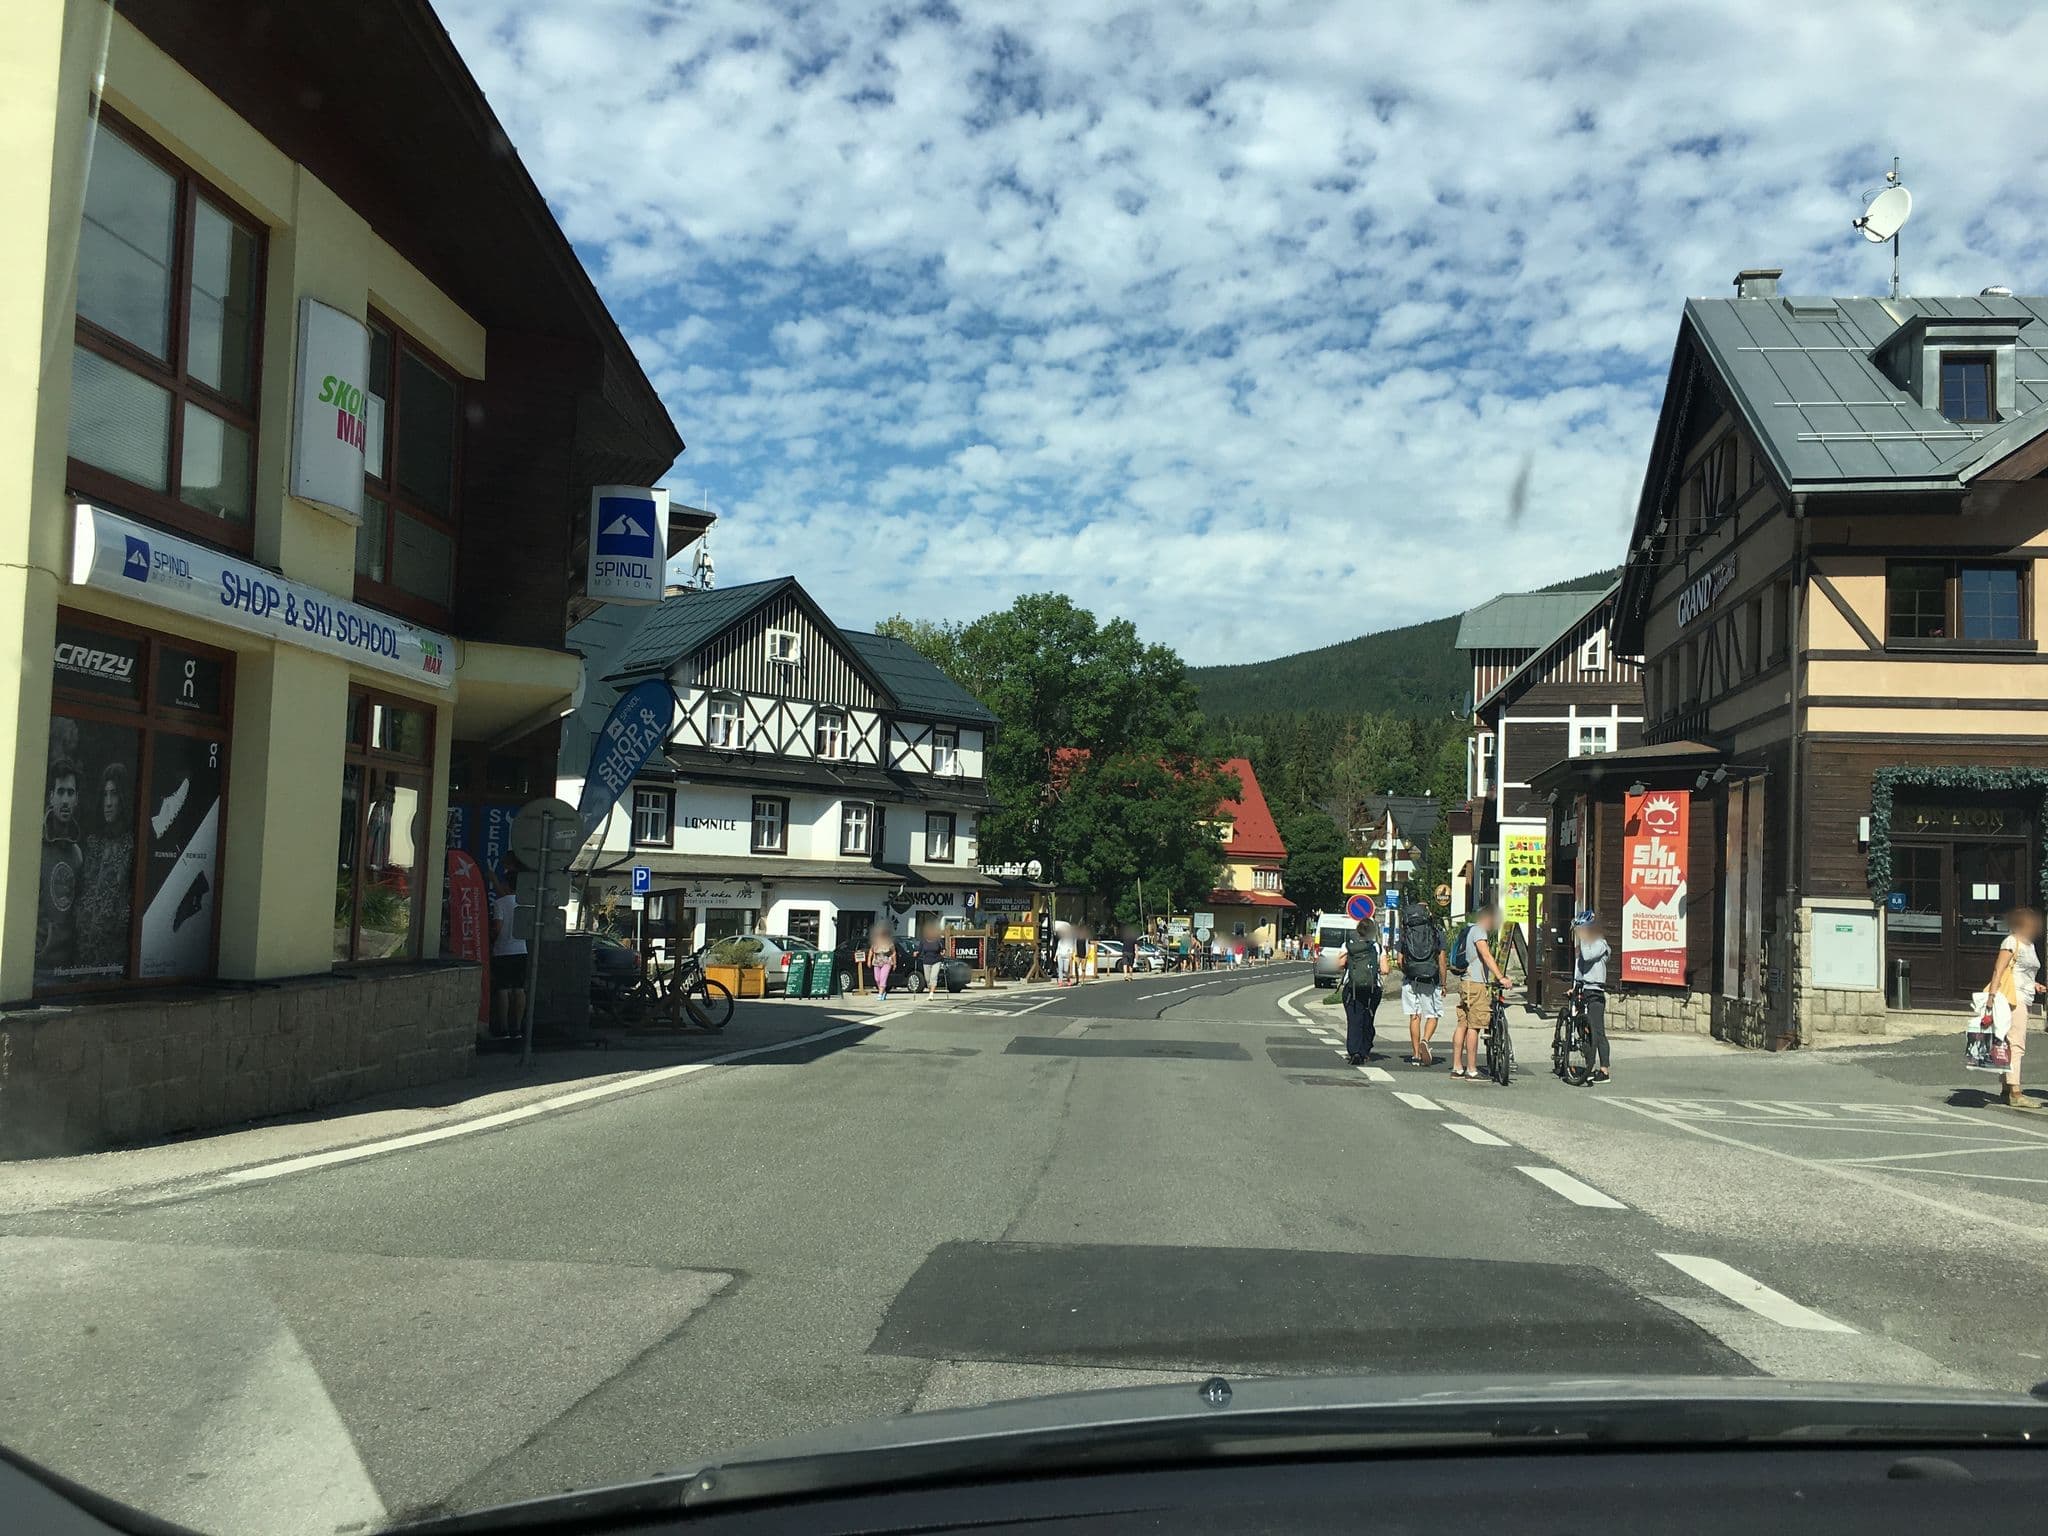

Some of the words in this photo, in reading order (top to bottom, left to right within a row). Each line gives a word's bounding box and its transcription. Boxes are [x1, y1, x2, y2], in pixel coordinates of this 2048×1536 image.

[154, 551, 193, 580] SPINDL
[595, 561, 652, 580] SPINDL
[594, 579, 652, 590] MOTION
[1678, 573, 1711, 628] GRAND
[220, 571, 280, 618] SHOP
[284, 592, 299, 627] &
[303, 599, 332, 637] SKI
[336, 611, 400, 660] SCHOOL
[54, 643, 134, 676] CRAZY
[422, 655, 443, 675] MAX
[598, 723, 639, 781] SHOP
[640, 708, 657, 725] &
[606, 722, 668, 794] RENTAL
[684, 816, 737, 831] LOMNICE
[1632, 836, 1676, 868] ski
[636, 870, 647, 886] P
[1630, 865, 1681, 886] rent
[1632, 919, 1679, 932] RENTAL
[1631, 930, 1679, 942] SCHOOL
[956, 947, 979, 956] LOMNICE
[1630, 956, 1680, 968] EXCHANGE
